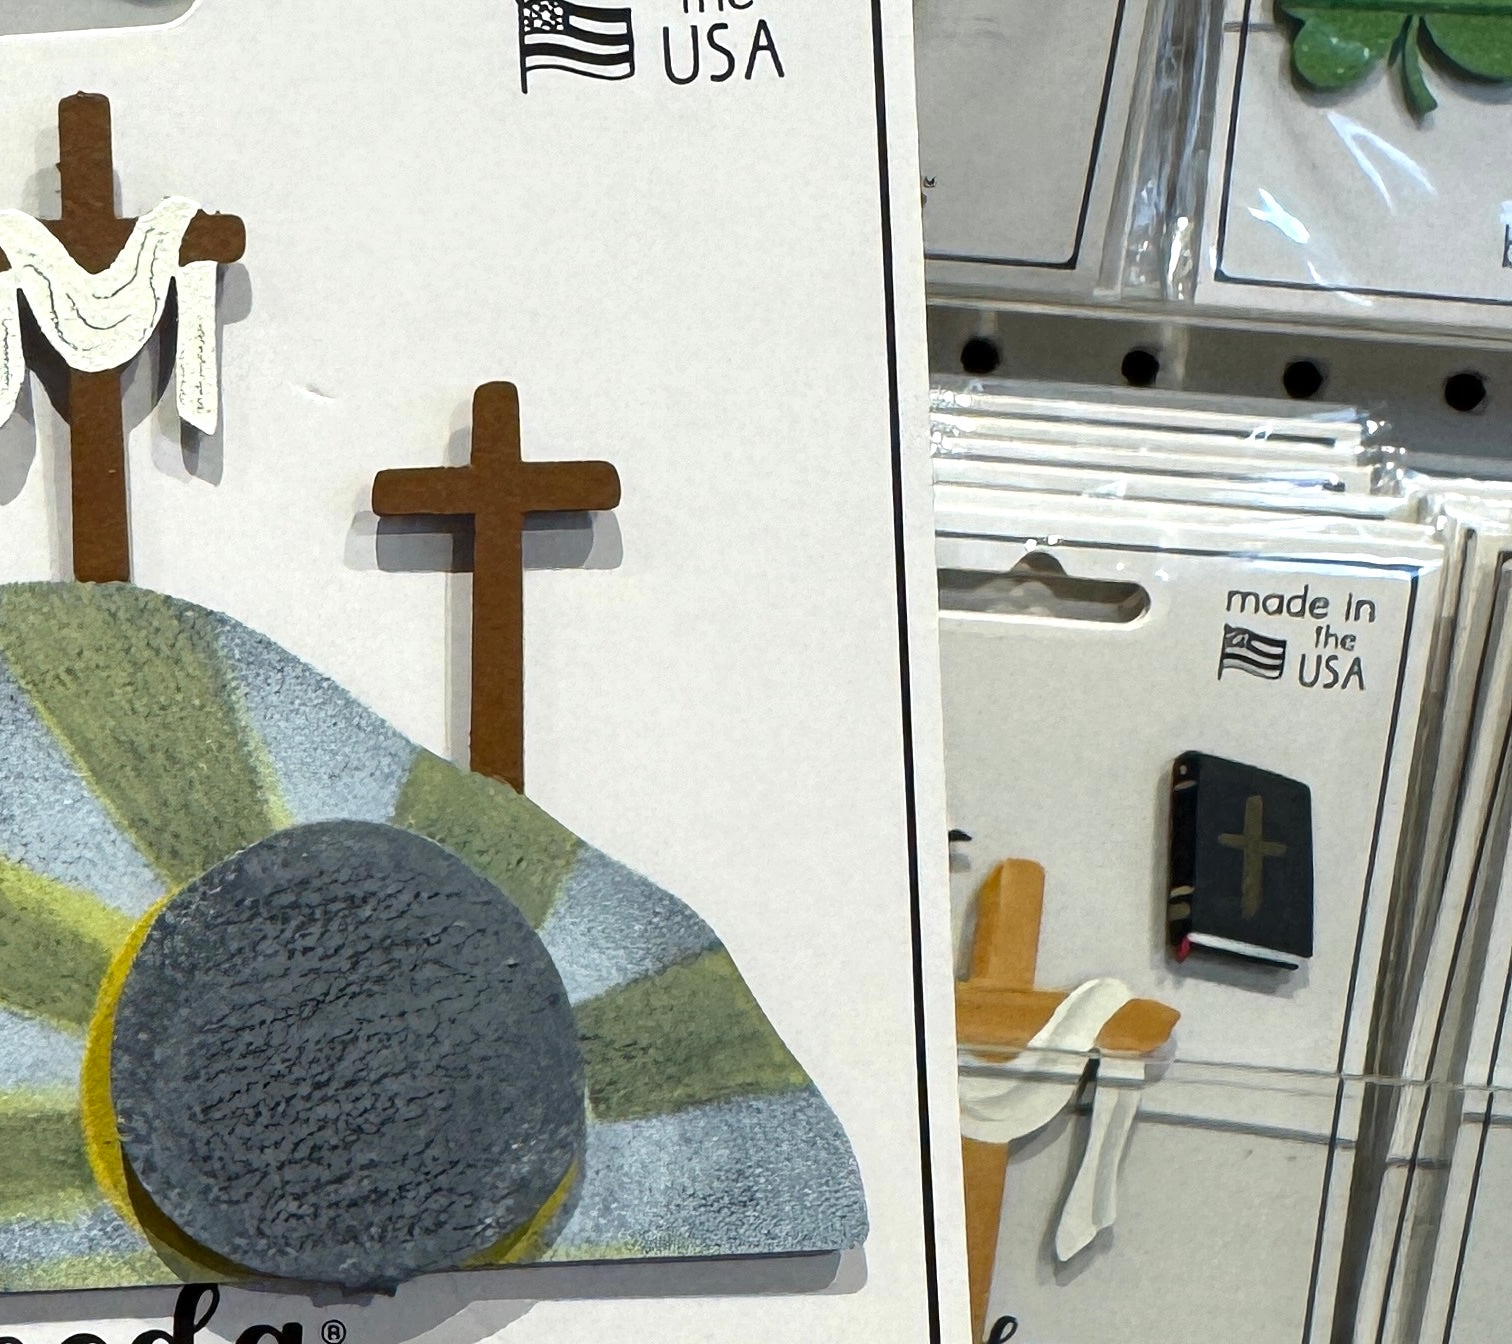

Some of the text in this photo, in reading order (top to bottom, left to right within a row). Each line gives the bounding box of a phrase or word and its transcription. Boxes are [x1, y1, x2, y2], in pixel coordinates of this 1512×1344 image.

[662, 19, 785, 85] USA
[1225, 584, 1377, 623] made in
[1314, 623, 1357, 652] the
[1297, 653, 1366, 691] USA
